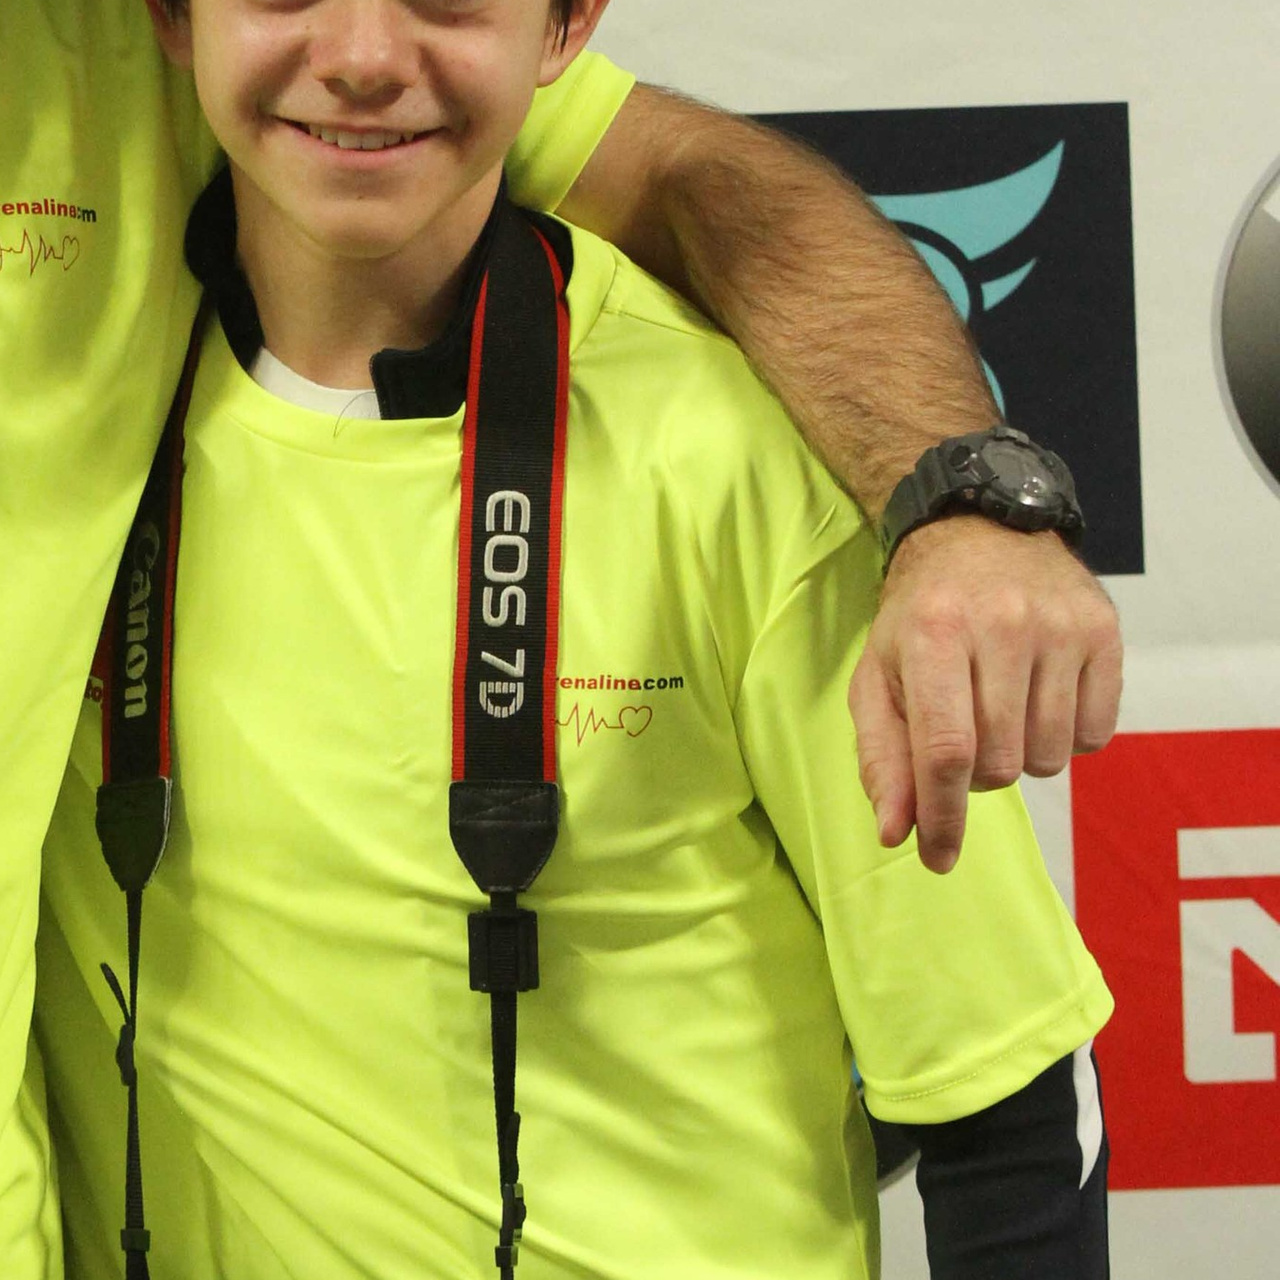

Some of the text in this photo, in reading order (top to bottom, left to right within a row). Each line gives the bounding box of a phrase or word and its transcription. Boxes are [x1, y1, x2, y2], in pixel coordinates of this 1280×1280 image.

[124, 520, 159, 718] Canon
[479, 490, 531, 718] EOS 7D
[557, 674, 685, 691] enaline.com
